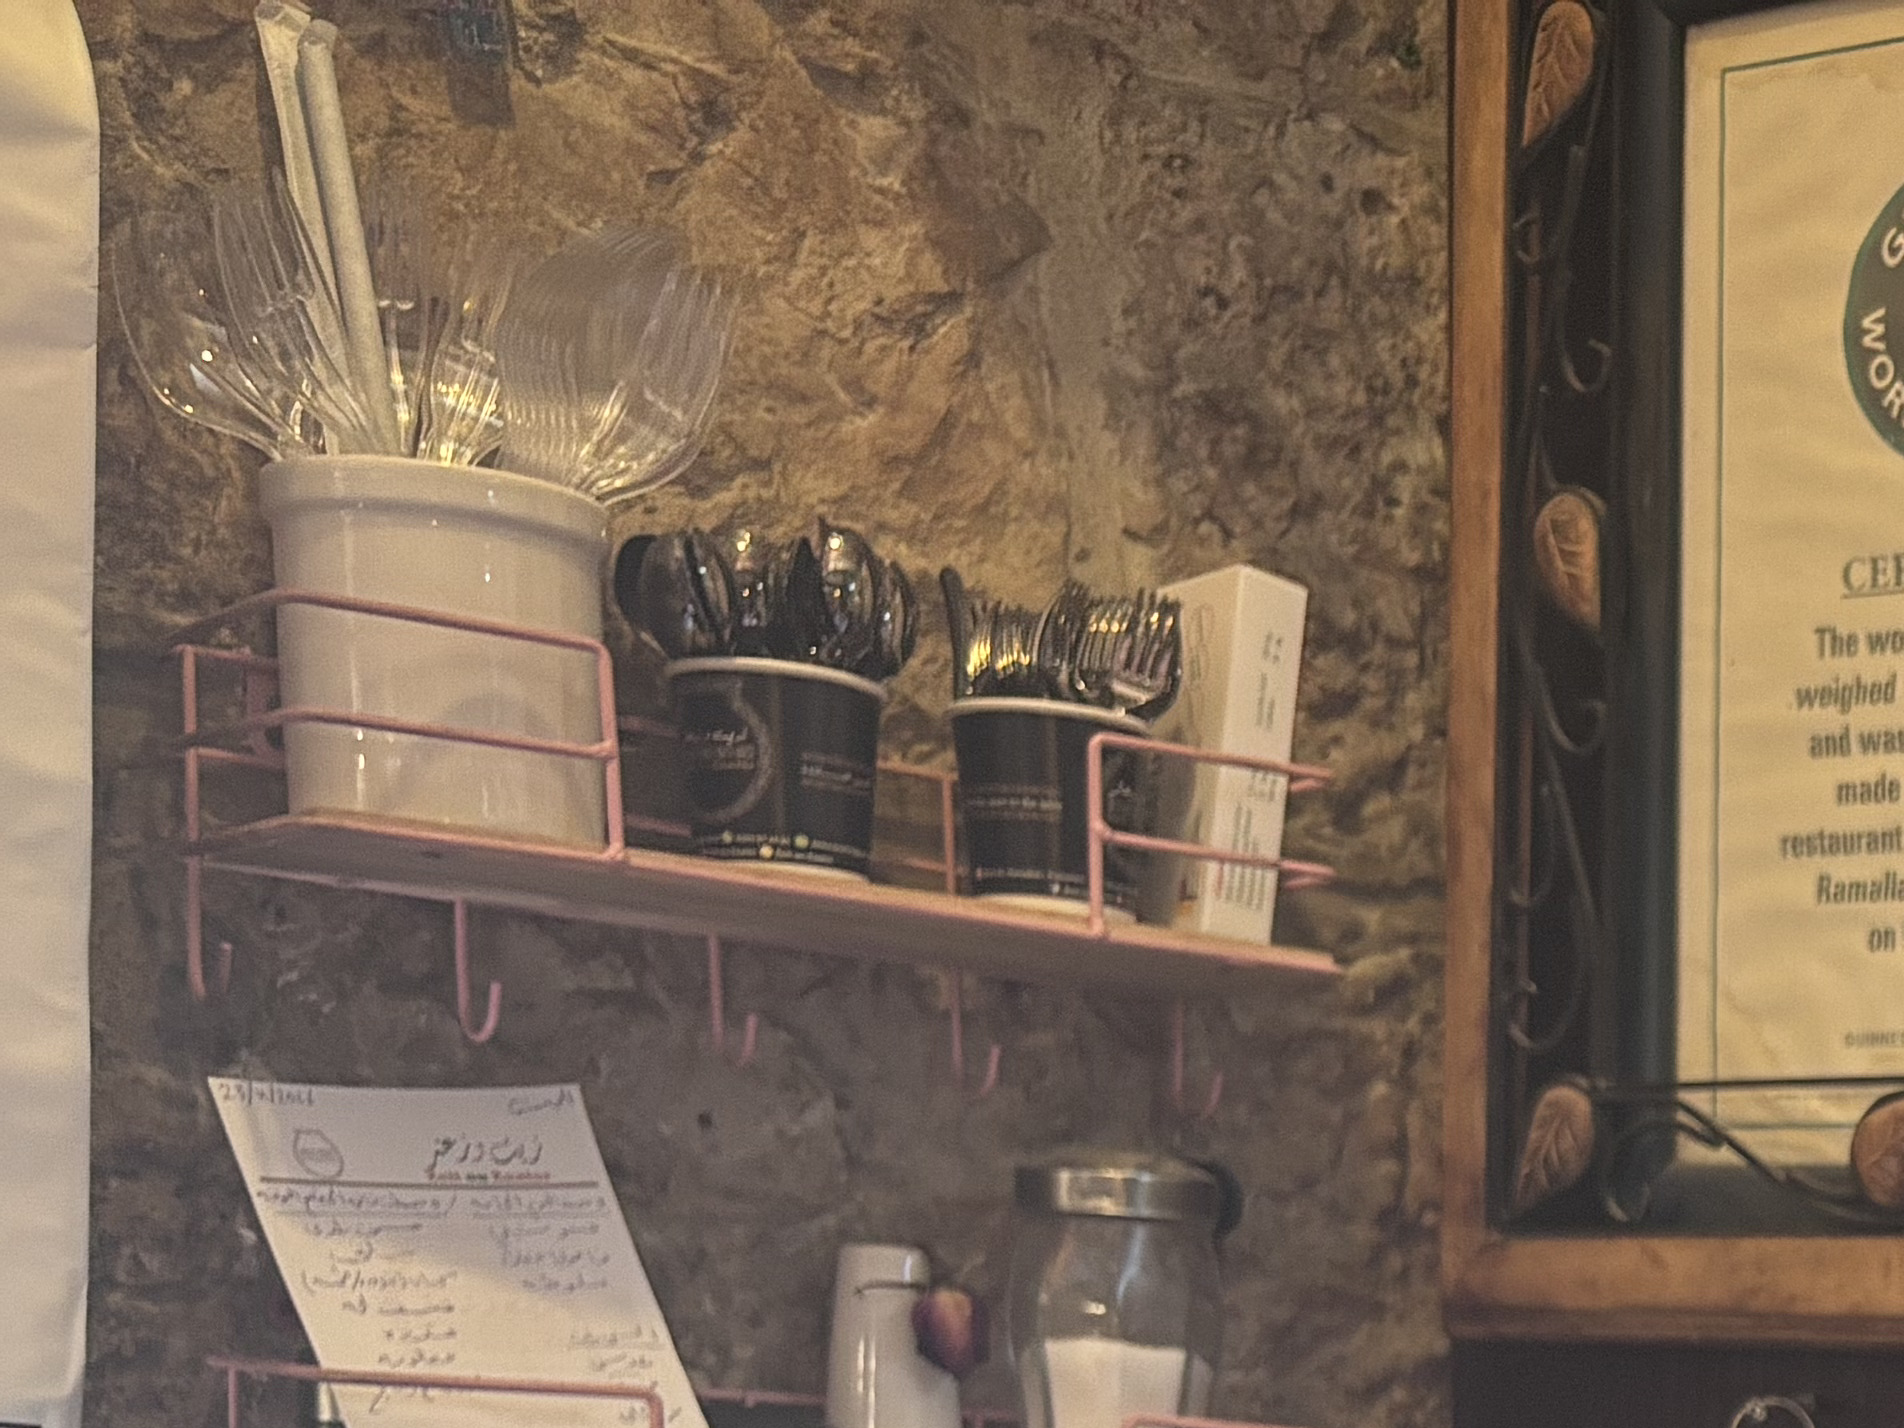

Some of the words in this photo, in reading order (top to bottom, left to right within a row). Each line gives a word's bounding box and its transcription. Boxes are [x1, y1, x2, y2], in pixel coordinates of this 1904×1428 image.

[1815, 624, 1858, 659] The
[1794, 672, 1897, 715] weighed
[1809, 724, 1851, 759] and
[1837, 771, 1900, 806] made
[1779, 822, 1904, 860] restaurant
[1868, 925, 1896, 953] on
